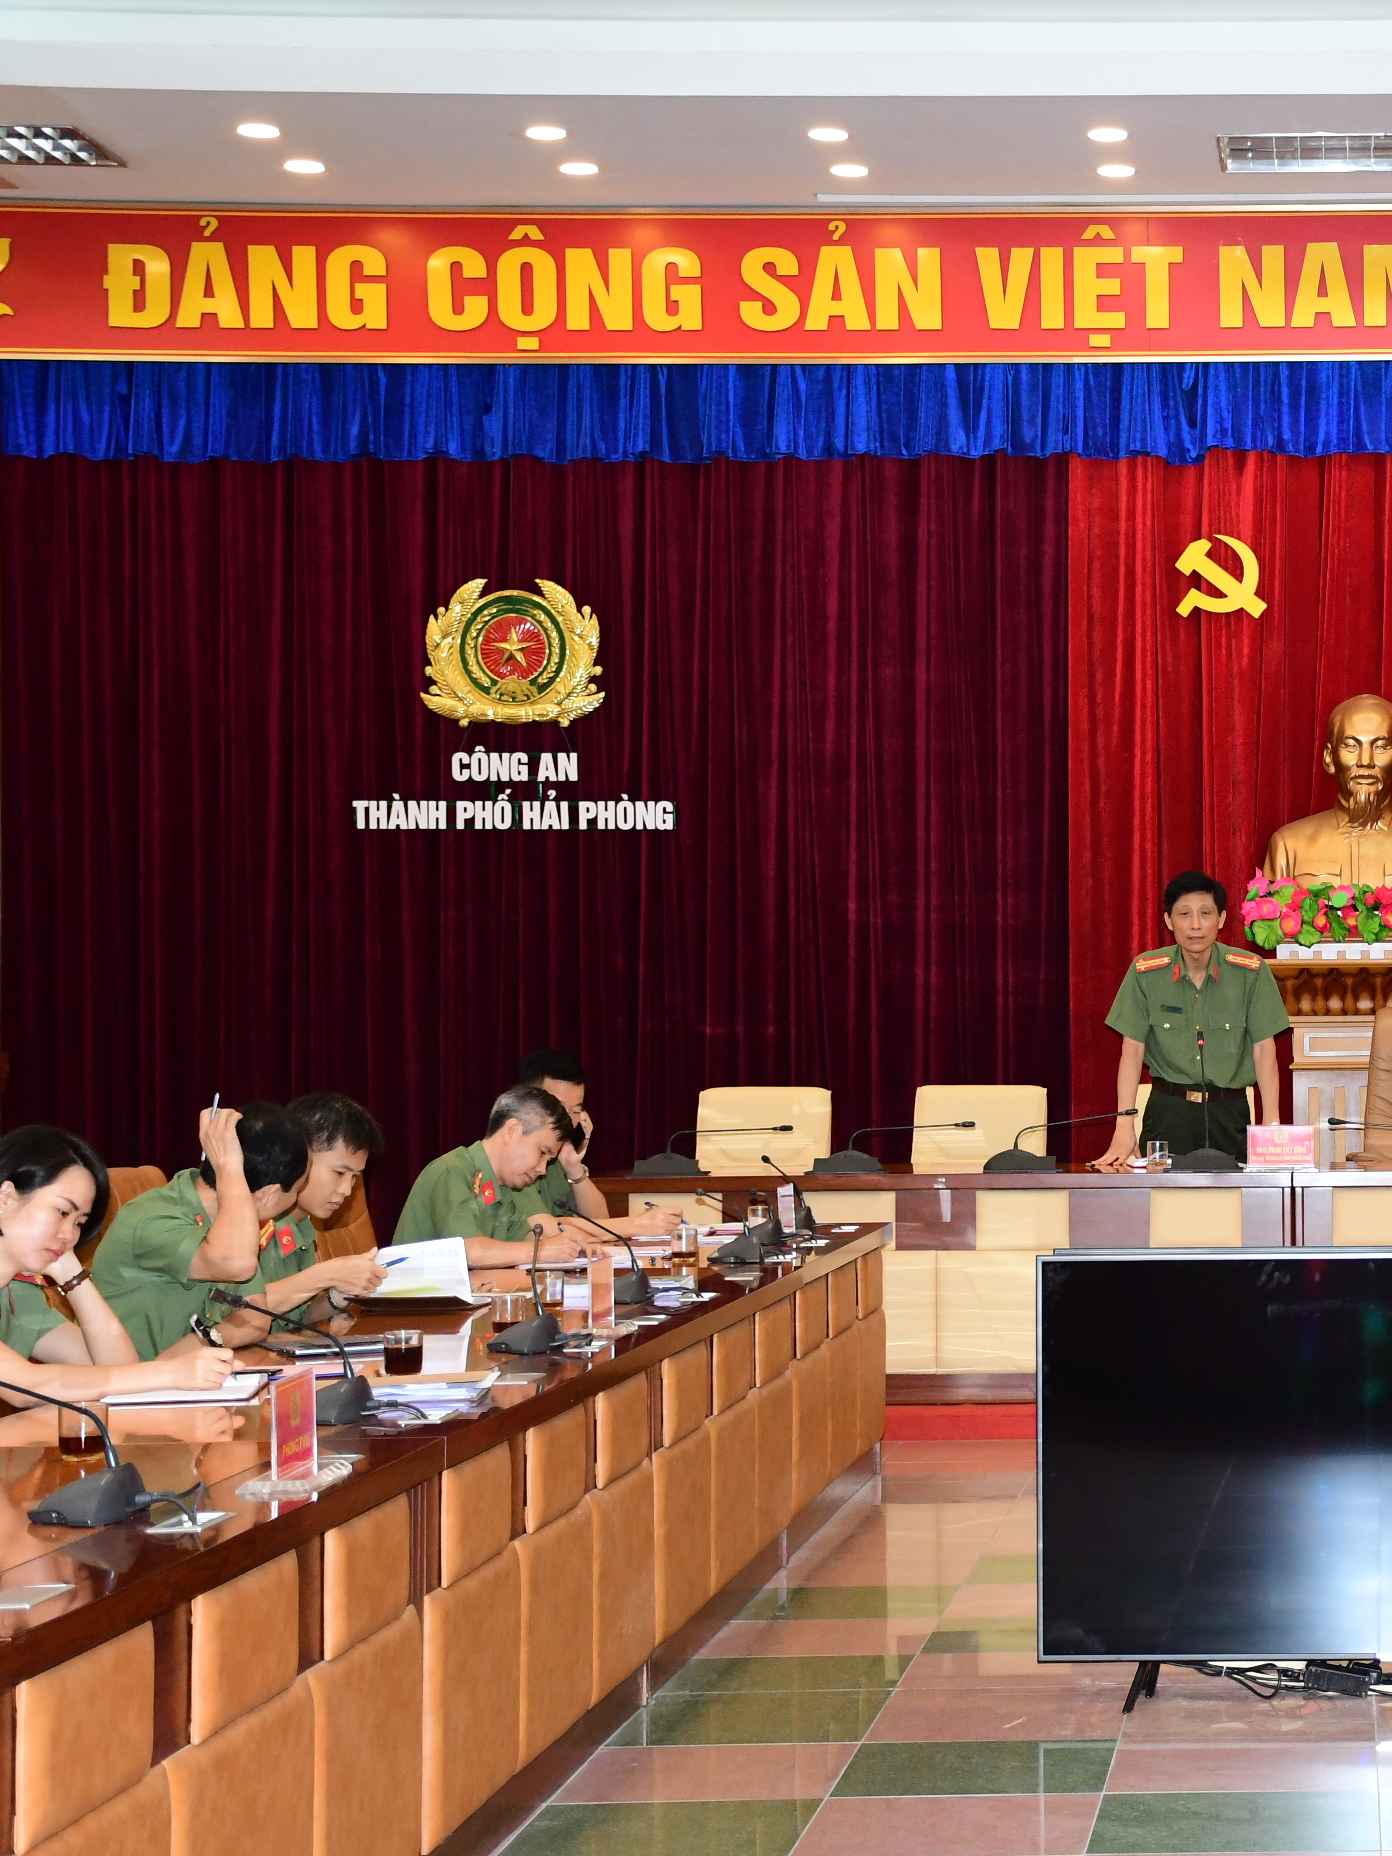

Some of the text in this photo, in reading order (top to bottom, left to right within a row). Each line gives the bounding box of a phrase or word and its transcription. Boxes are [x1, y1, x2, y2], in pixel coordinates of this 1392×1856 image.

[104, 216, 388, 330] ĐẢNG
[427, 224, 703, 351] CỘNG
[739, 220, 943, 332] SẢN
[974, 224, 1184, 347] VIỆT
[452, 746, 579, 781] CÔNG AN
[353, 789, 674, 830] THÀNH PHỐ HẢI PHÒNG
